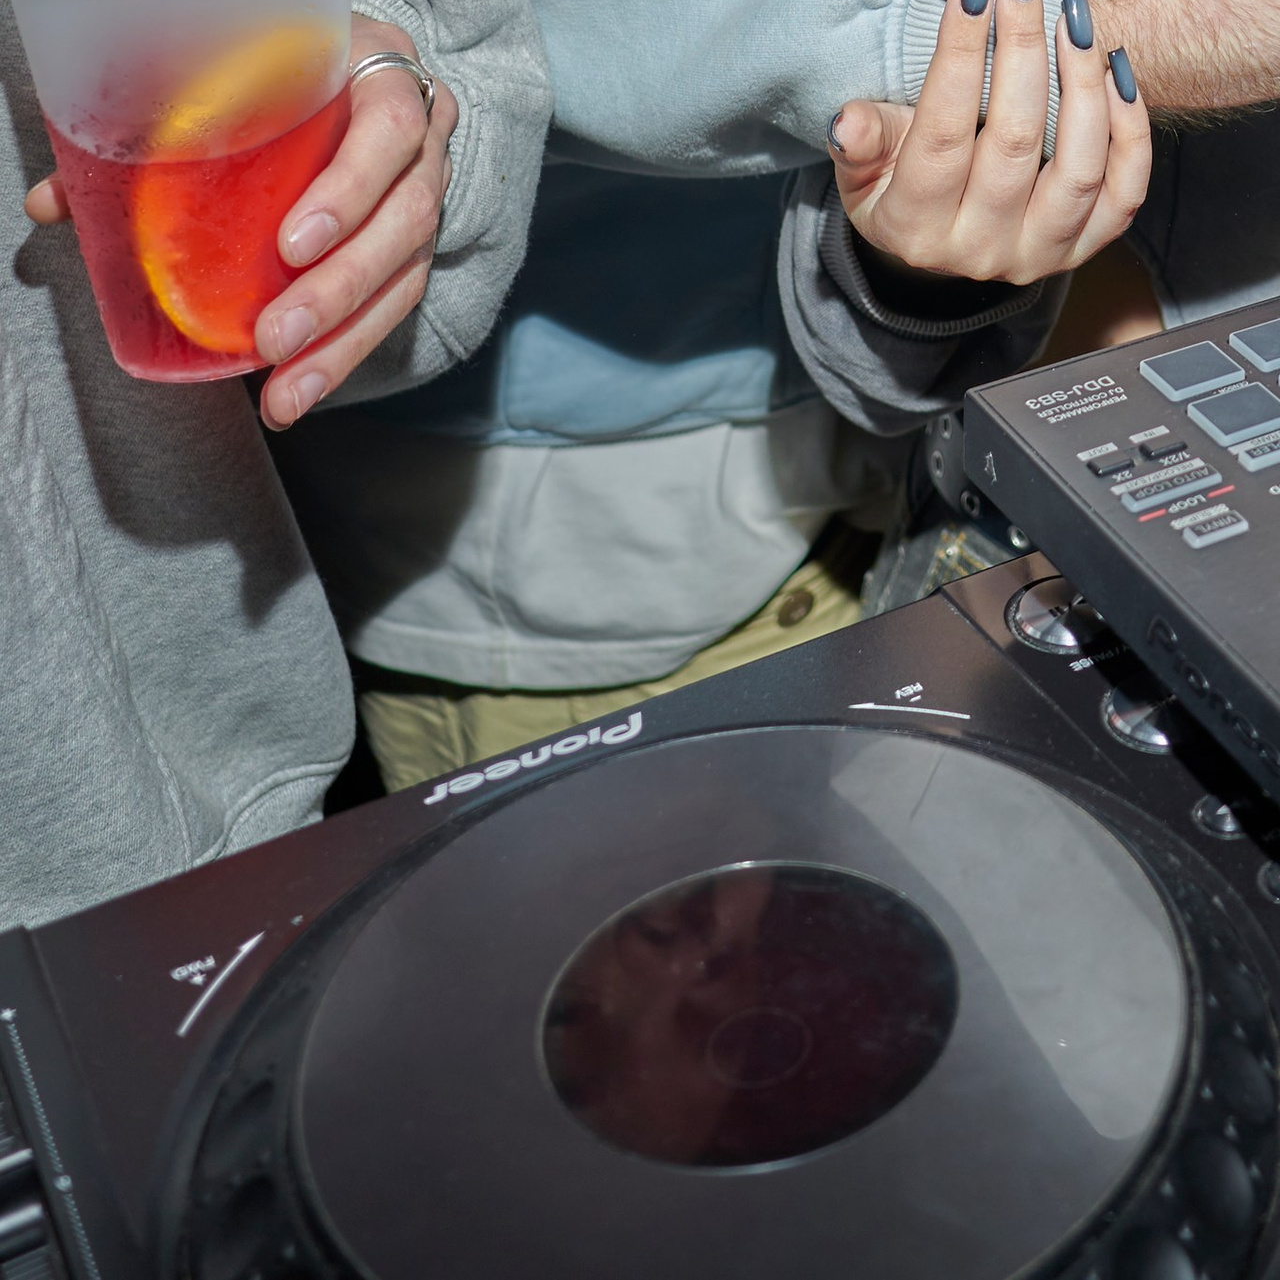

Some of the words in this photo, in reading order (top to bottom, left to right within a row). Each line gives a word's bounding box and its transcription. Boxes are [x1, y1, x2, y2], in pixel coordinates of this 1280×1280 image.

[1025, 375, 1116, 410] DDJ-SB3
[1108, 386, 1125, 397] DJ
[1036, 391, 1108, 419] CONTROLLER
[1046, 394, 1128, 424] PERFORMANCE
[1142, 429, 1156, 438] IN
[1087, 445, 1110, 457] OUT
[1158, 450, 1191, 467] 1/2X
[1111, 470, 1133, 483] 2X
[1124, 462, 1195, 490] RELOOP/EXIT
[1172, 467, 1210, 485] AUTO
[1134, 481, 1172, 500] LOOP
[1167, 494, 1207, 514] LOOP
[1193, 515, 1238, 533] VINYL
[894, 682, 924, 700] REV
[422, 710, 643, 806] Pioneer
[170, 954, 217, 983] FWD
